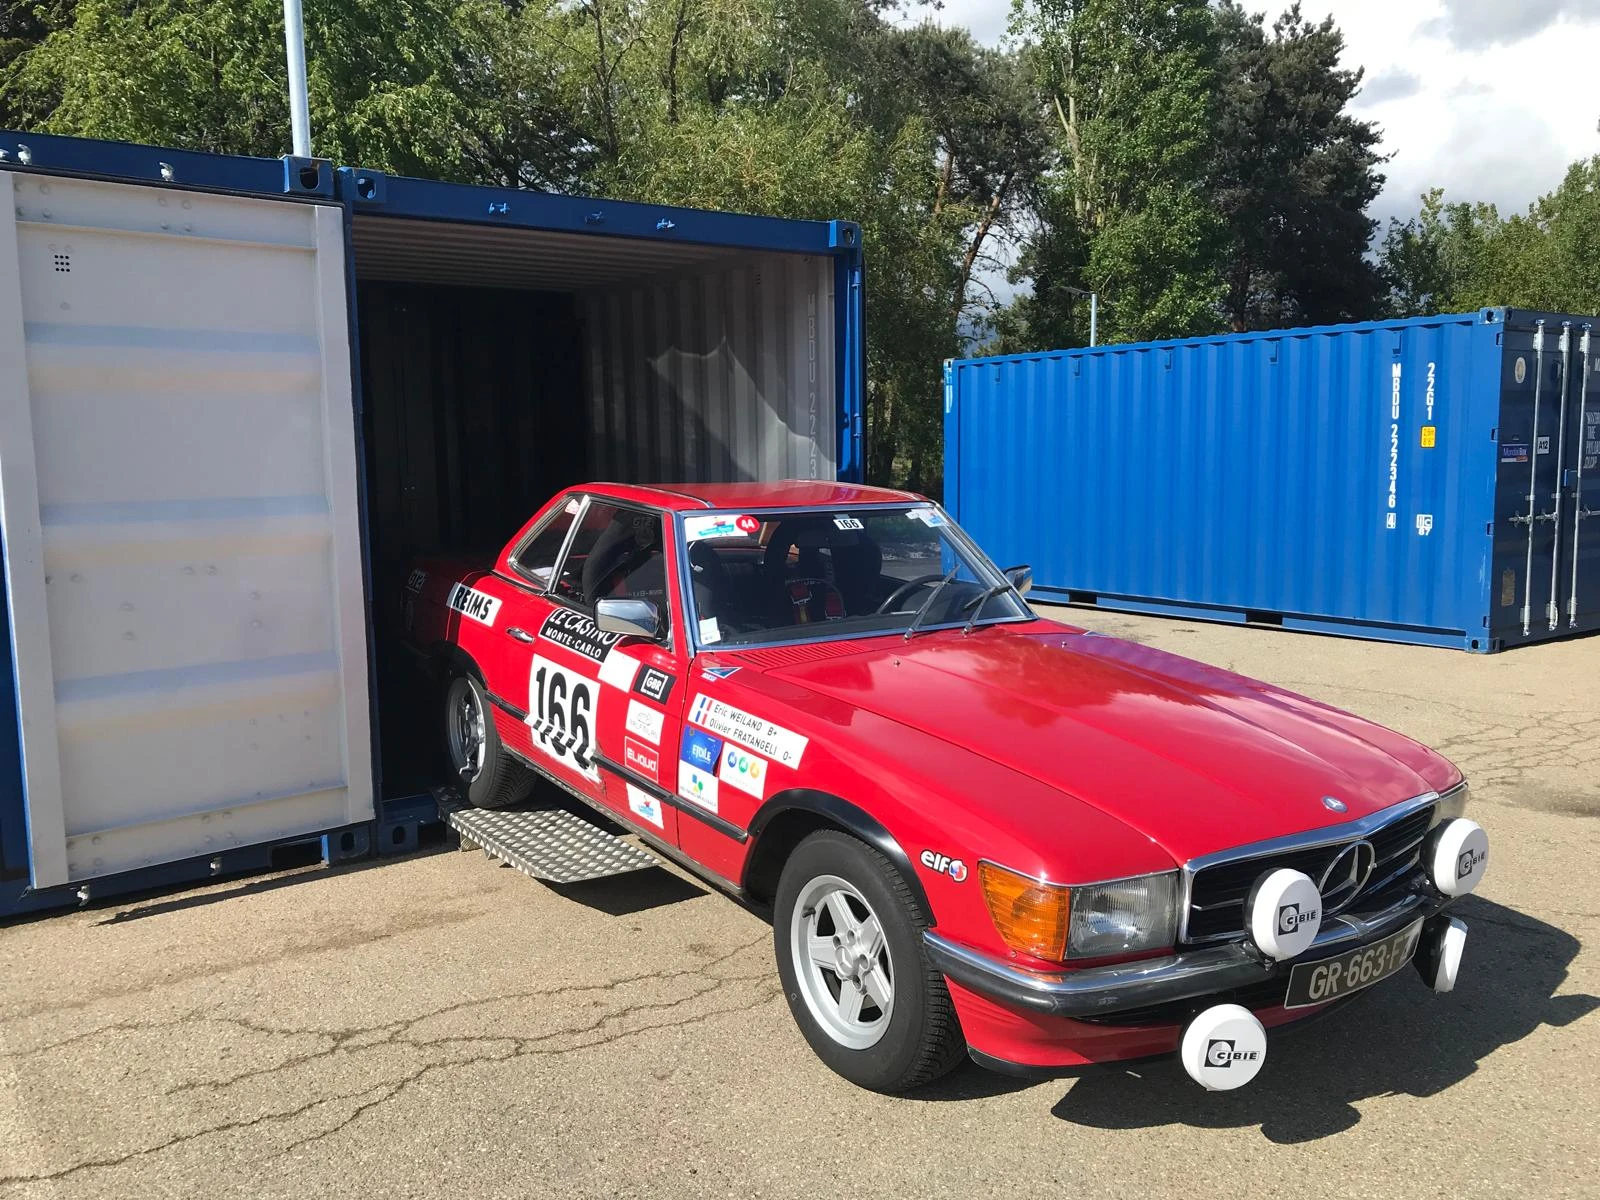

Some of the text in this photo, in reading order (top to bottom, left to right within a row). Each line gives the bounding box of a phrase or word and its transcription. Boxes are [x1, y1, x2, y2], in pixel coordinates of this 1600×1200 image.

[1391, 363, 1401, 420] MBDU
[1426, 362, 1435, 420] 22G1
[1538, 440, 1548, 450] A12
[1388, 423, 1399, 508] 222346
[837, 519, 860, 529] 166
[453, 586, 493, 620] REIMS
[549, 608, 572, 625] LE
[646, 676, 662, 691] GBR
[536, 666, 591, 770] 166
[713, 703, 778, 737] Eric WEILAND B+
[709, 718, 731, 734] Olivier
[733, 729, 778, 756] FRATANGELI
[920, 849, 951, 874] elf
